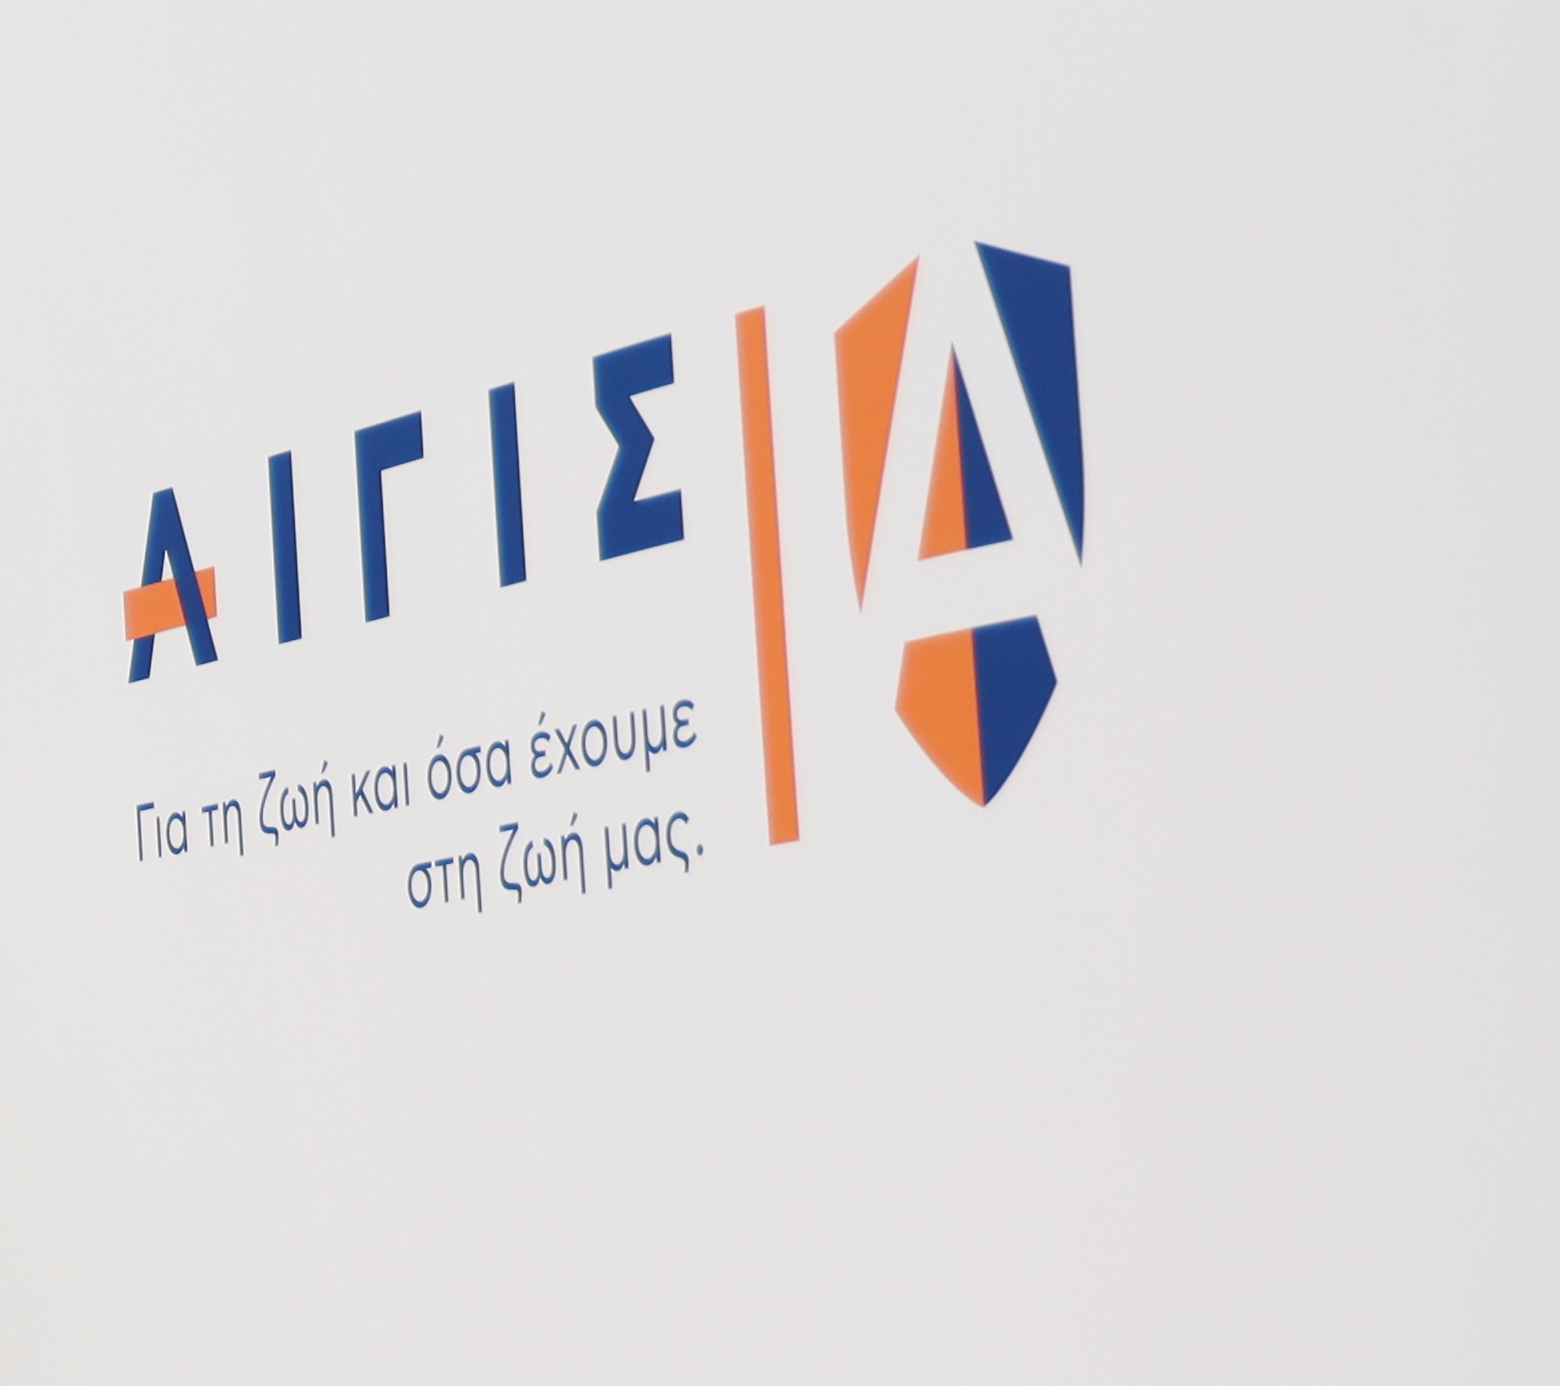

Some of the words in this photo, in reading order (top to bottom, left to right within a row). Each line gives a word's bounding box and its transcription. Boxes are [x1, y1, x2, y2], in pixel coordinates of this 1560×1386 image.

[122, 332, 686, 684] ΑΙΓΙΣ
[134, 798, 189, 862] Για
[200, 785, 246, 857] τη
[258, 757, 336, 842] ζωή
[350, 751, 411, 819] και
[426, 732, 513, 800] όσα
[528, 695, 698, 778] έχουμε
[406, 847, 483, 914] στη
[498, 812, 586, 903] ζωή
[604, 808, 706, 888] μας.
